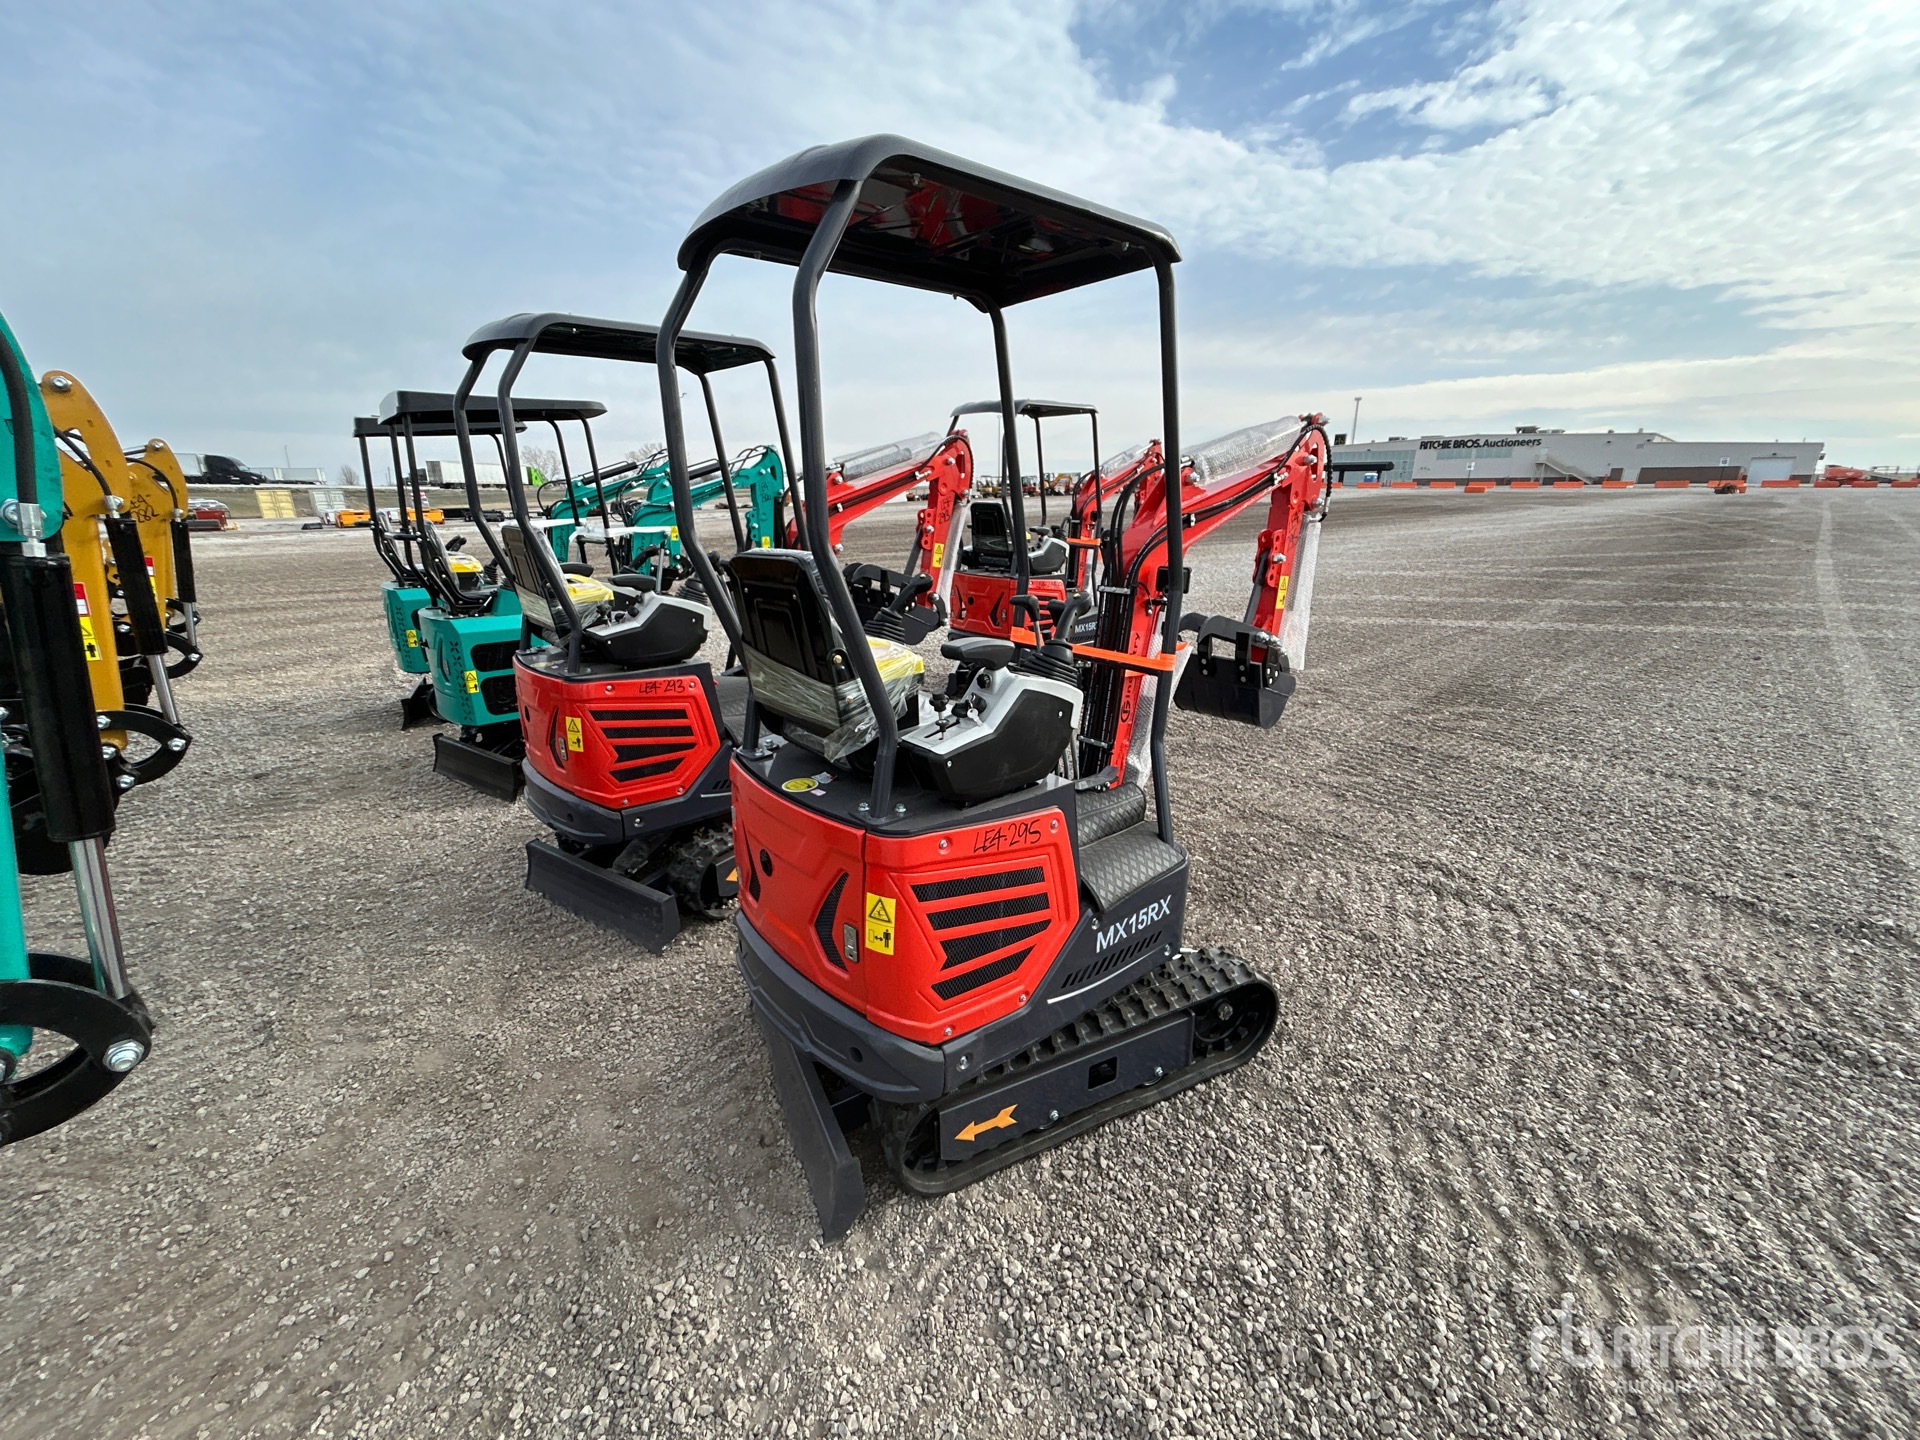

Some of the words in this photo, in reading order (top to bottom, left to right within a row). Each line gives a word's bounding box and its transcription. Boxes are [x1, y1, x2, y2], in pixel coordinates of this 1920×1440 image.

[1420, 440, 1452, 450] RITCHIE
[1483, 438, 1542, 448] Auctioneers
[1075, 621, 1097, 633] MX15R
[1096, 894, 1172, 954] MX15RX
